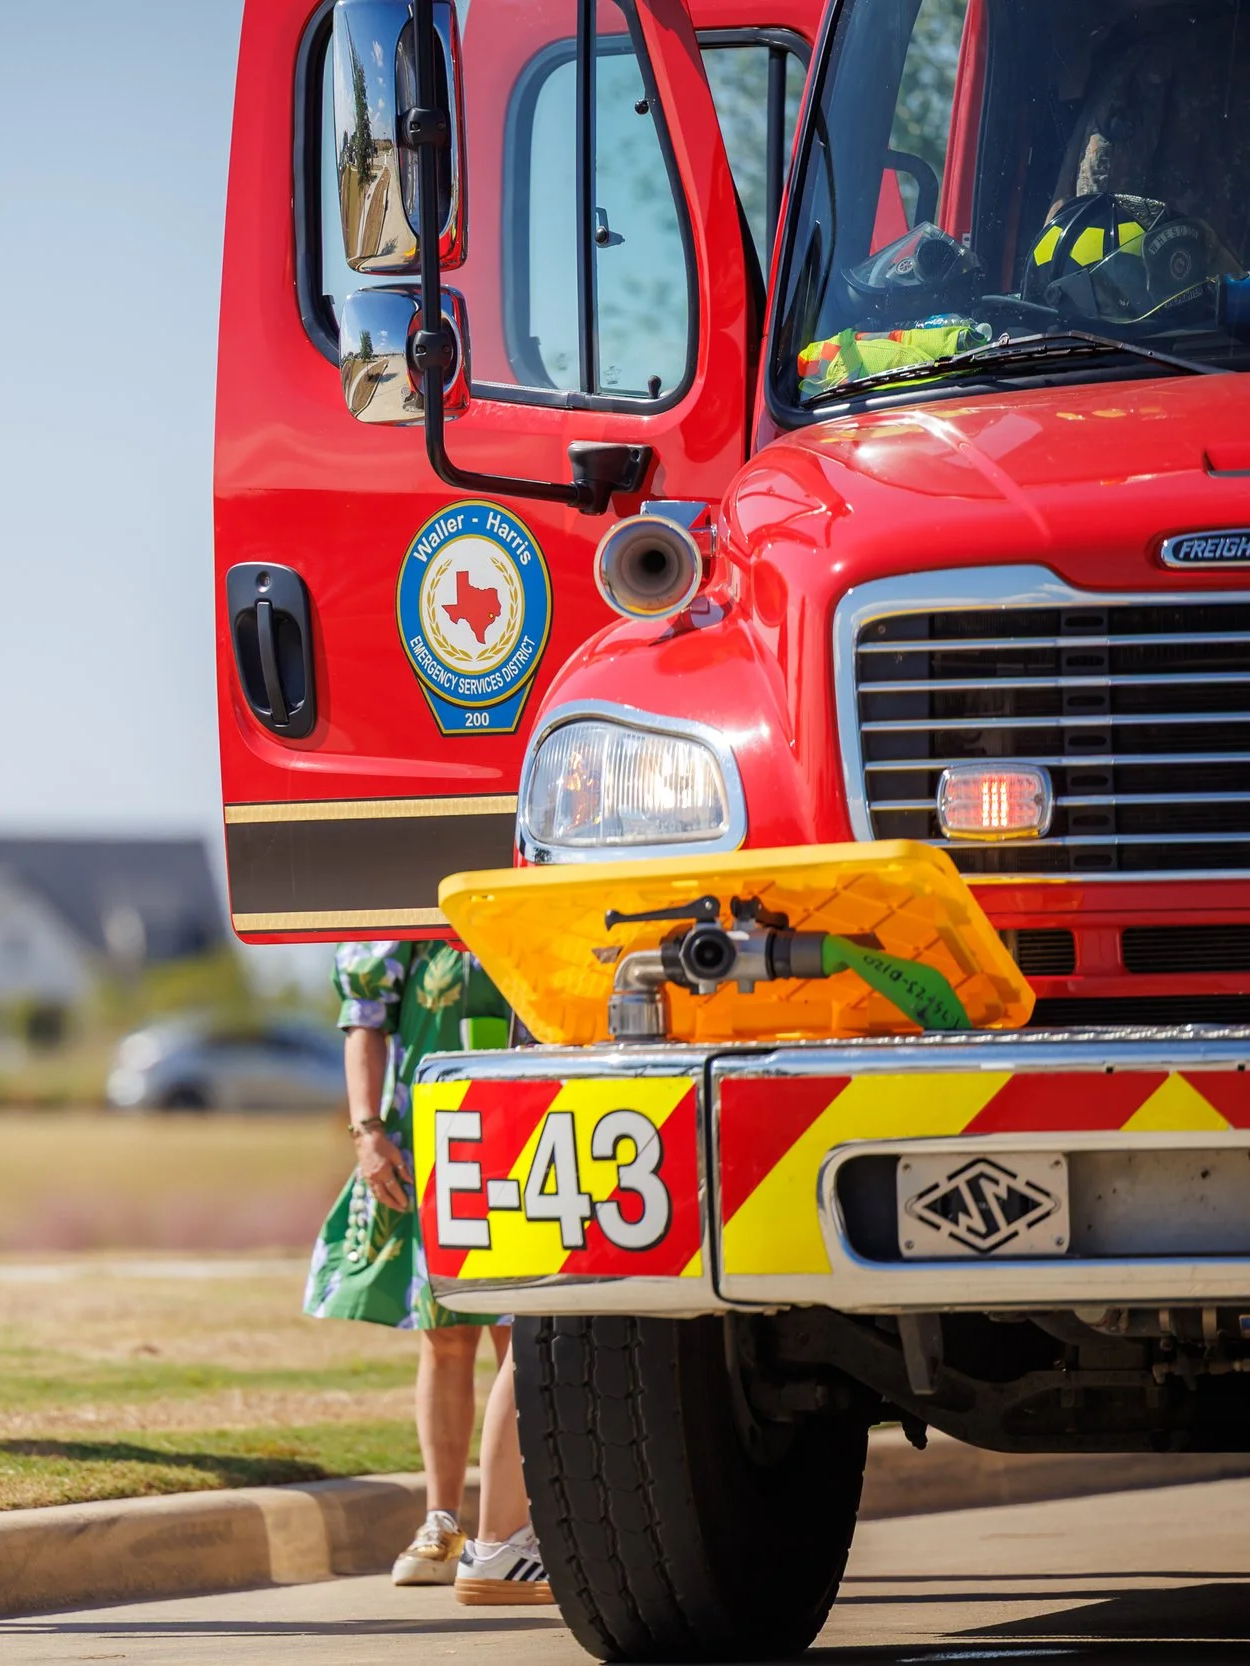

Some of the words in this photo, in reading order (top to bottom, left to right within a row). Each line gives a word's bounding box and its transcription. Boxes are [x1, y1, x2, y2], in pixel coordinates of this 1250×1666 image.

[413, 514, 465, 563] Waller
[486, 512, 532, 566] Harris
[410, 635, 458, 691] EMERGENCY
[458, 672, 504, 695] SERVICES
[504, 634, 536, 683] DISTRICT
[465, 712, 490, 727] 200
[434, 1108, 672, 1252] E-43
